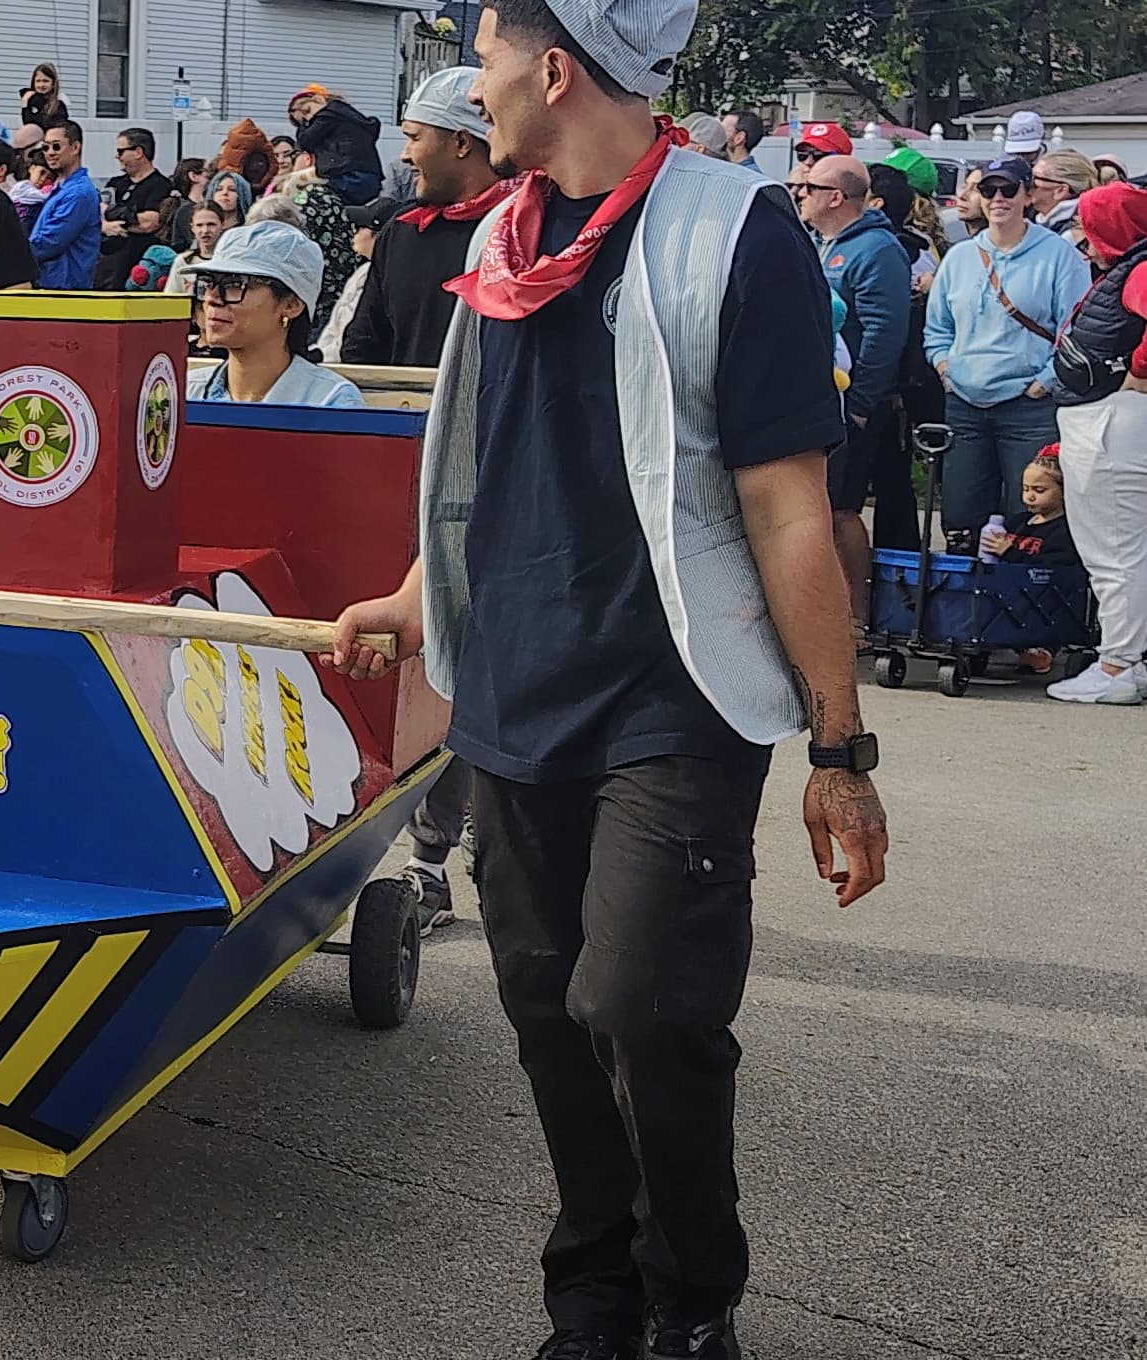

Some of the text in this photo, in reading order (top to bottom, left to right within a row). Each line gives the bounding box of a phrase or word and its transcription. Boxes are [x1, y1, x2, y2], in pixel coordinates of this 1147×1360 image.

[49, 379, 84, 411] PARK
[16, 477, 73, 500] DISTRICT
[74, 459, 86, 473] 91
